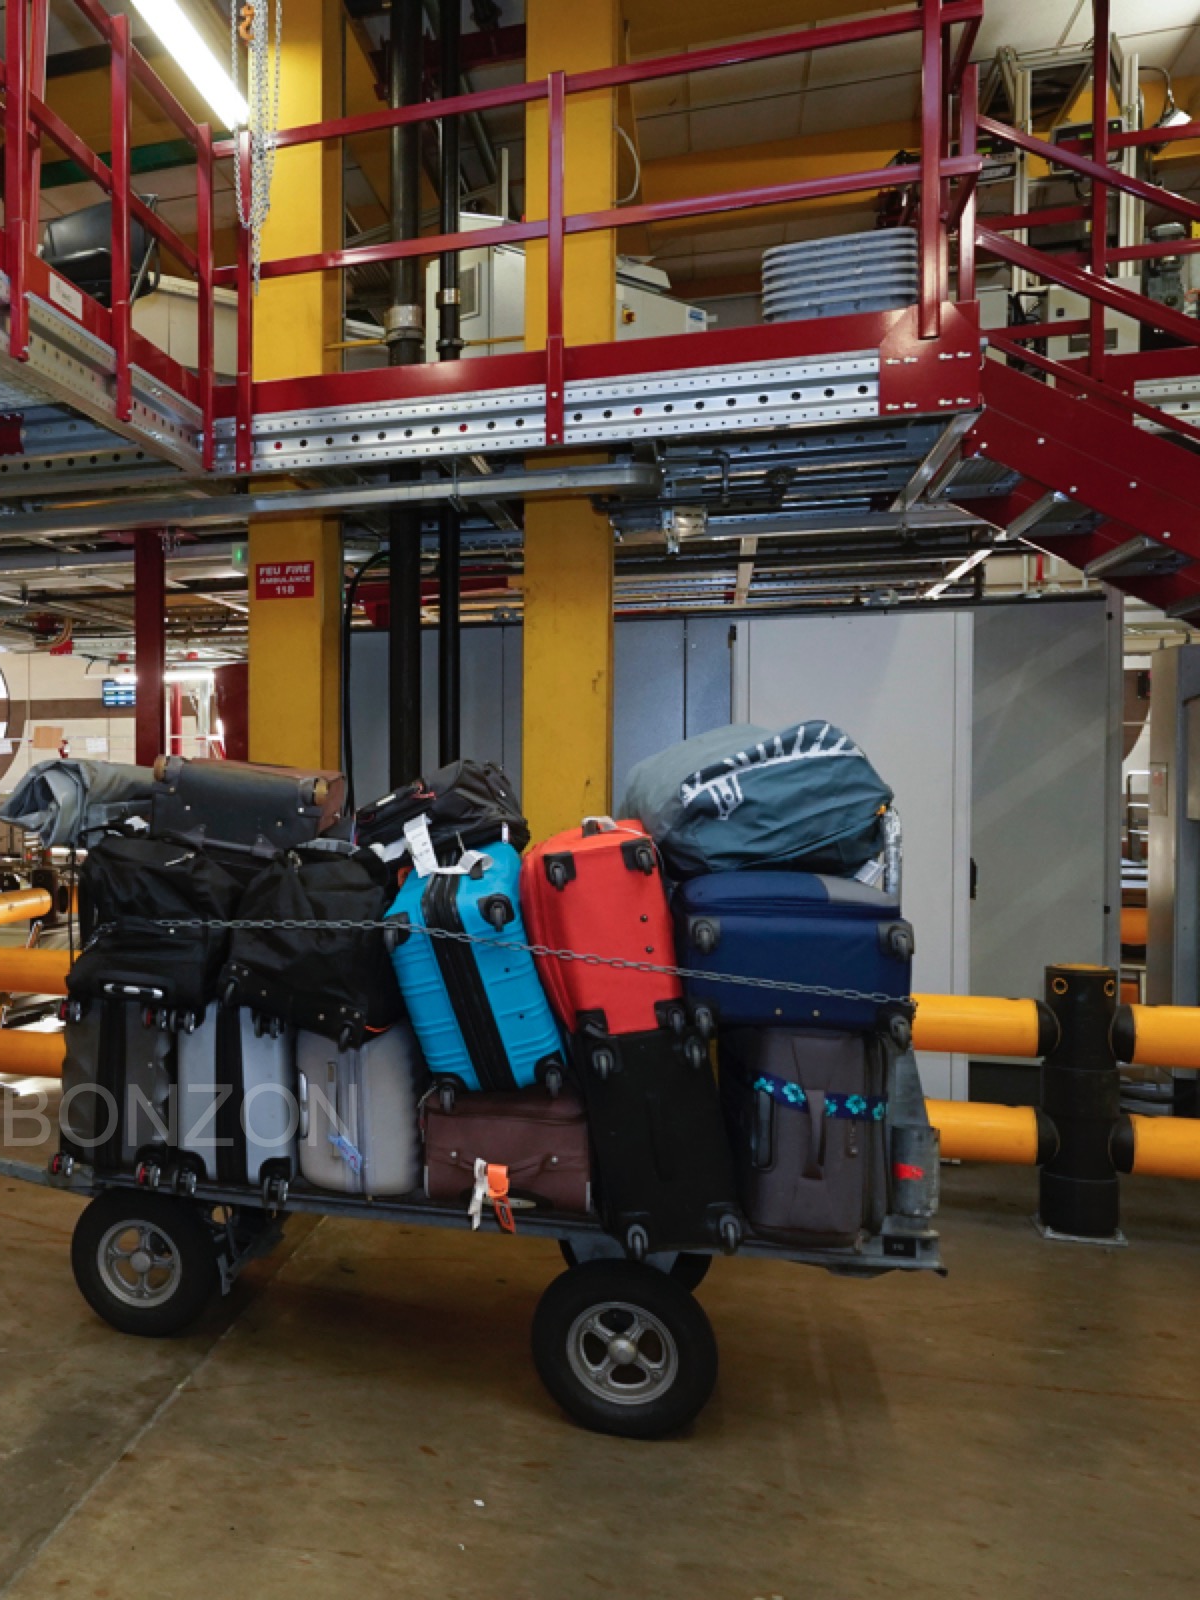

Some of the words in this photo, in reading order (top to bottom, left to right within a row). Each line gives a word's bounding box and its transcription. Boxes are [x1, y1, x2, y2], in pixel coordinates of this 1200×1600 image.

[260, 566, 280, 576] FEU
[286, 564, 311, 575] FIRE
[260, 576, 311, 584] AMBULANCE
